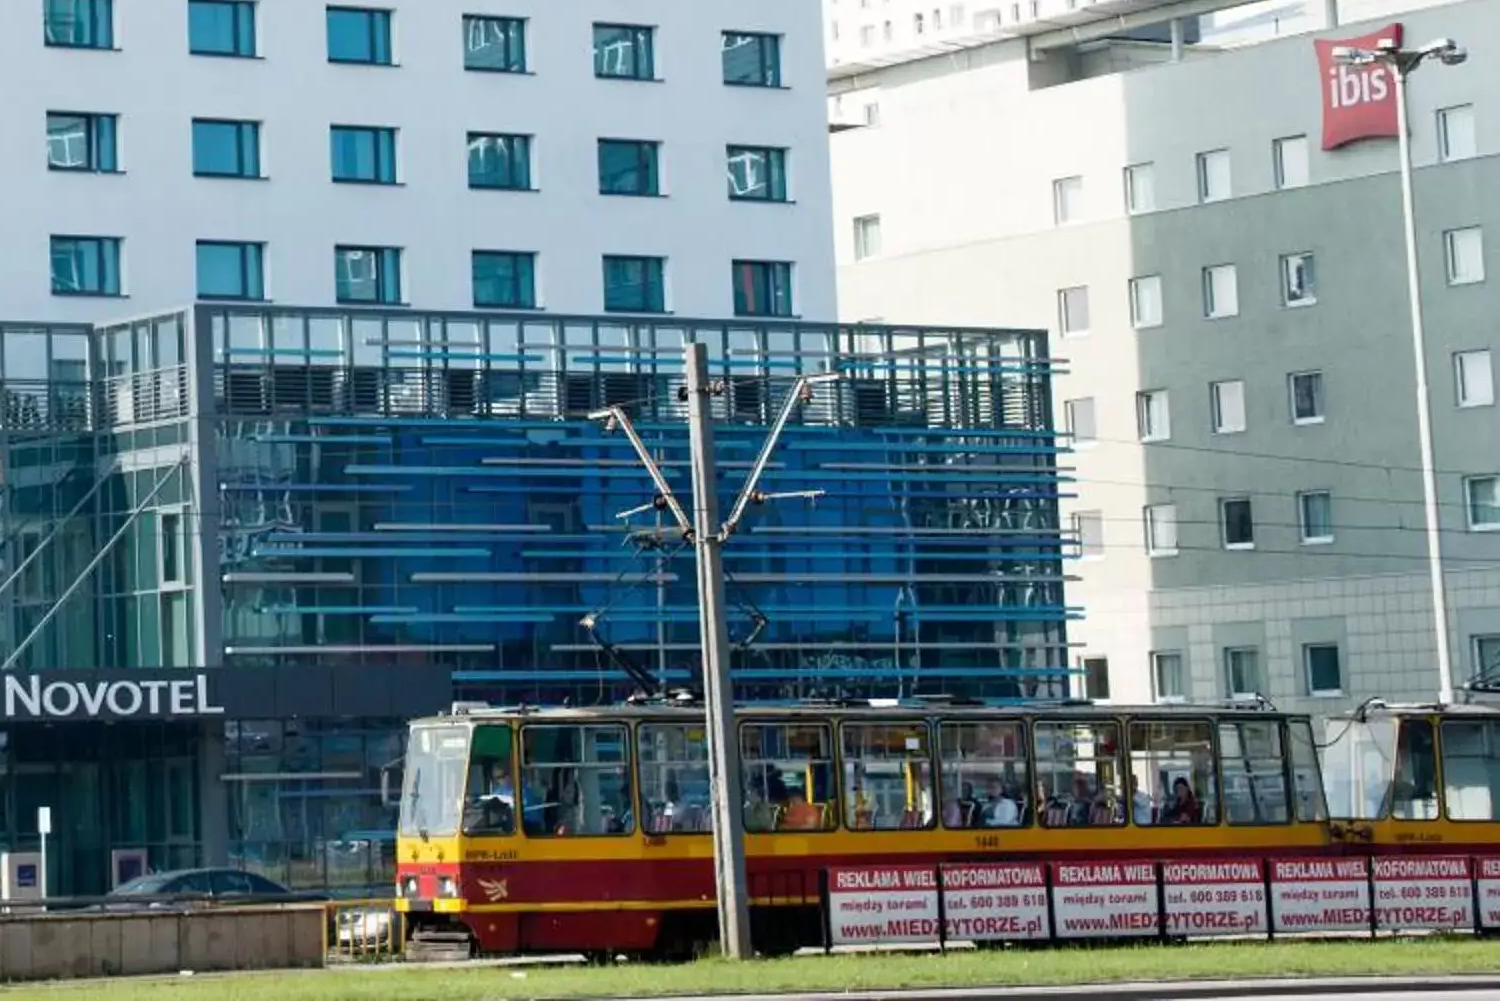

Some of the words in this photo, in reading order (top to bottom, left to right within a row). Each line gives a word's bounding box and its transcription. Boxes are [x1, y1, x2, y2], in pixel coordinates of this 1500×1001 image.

[1329, 64, 1388, 109] ibis
[5, 674, 225, 716] NOVOTEL
[837, 870, 901, 888] REKLAMA
[1059, 866, 1121, 884] REKLAMA
[1276, 861, 1334, 879] REKLAMA
